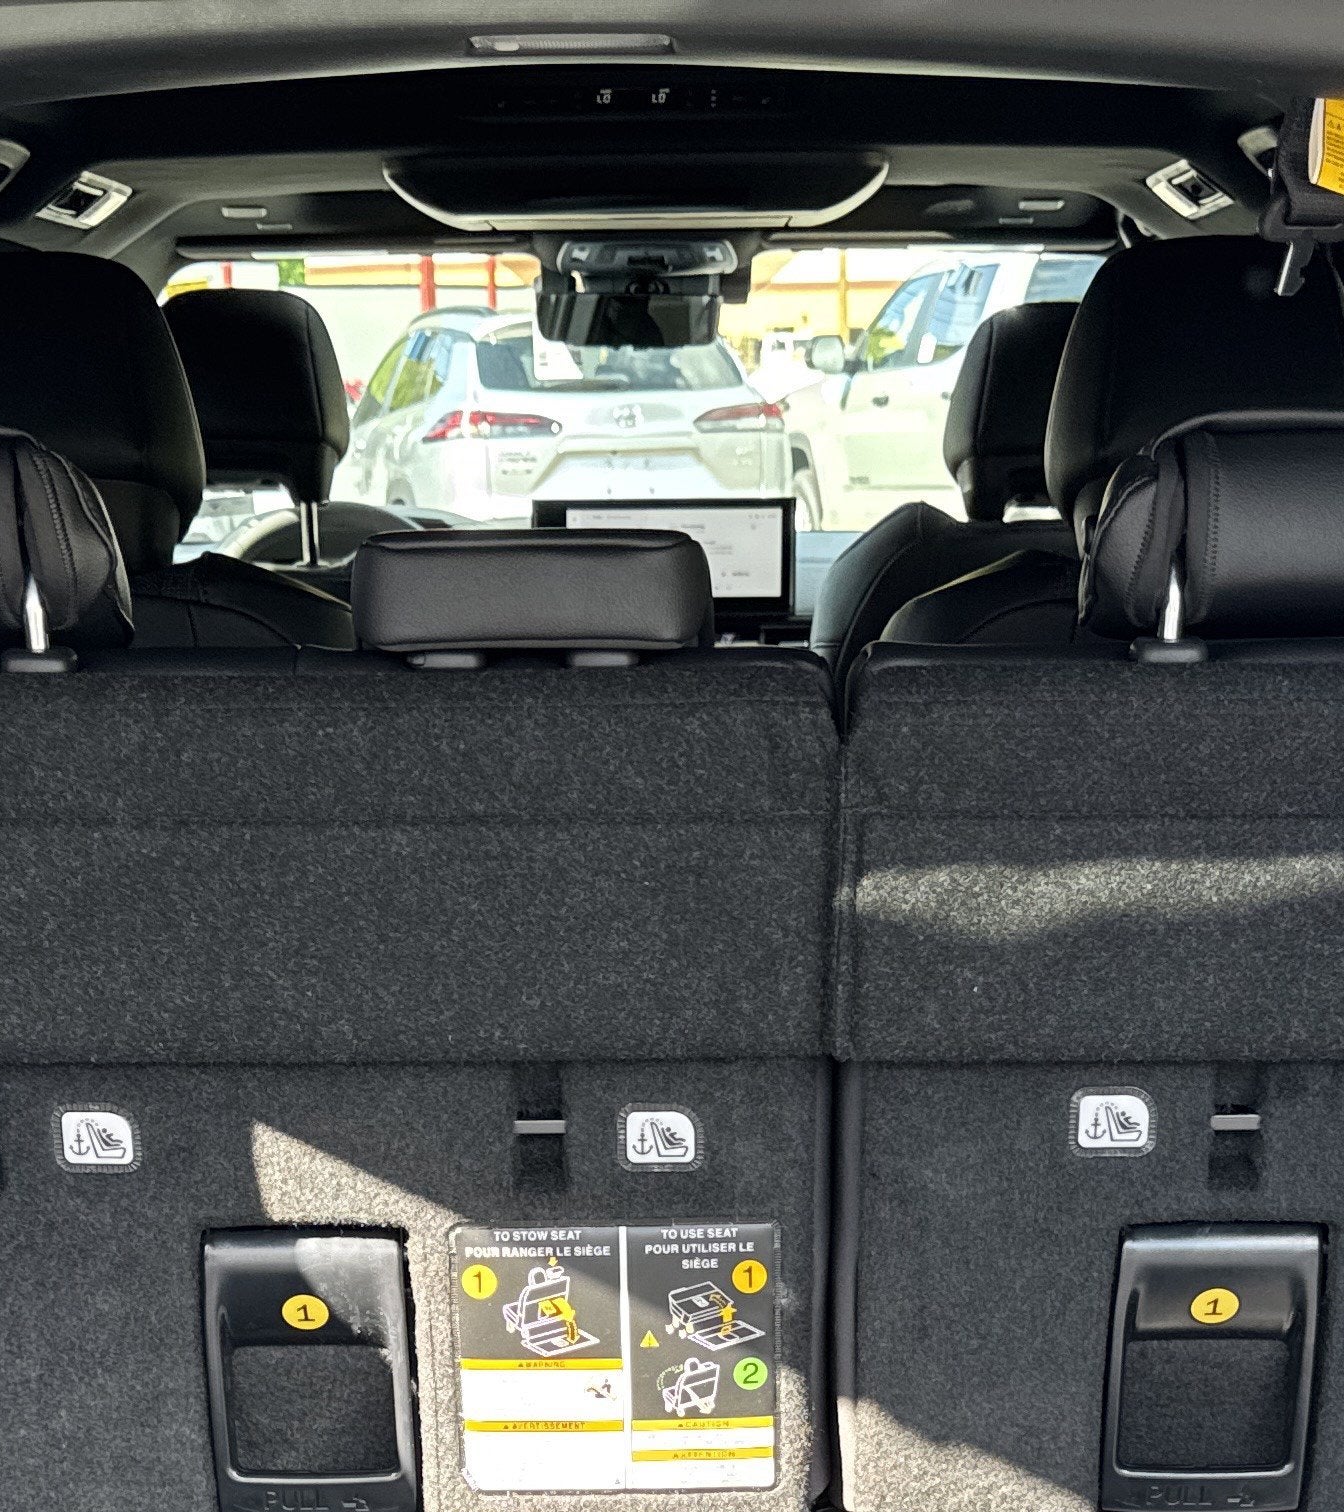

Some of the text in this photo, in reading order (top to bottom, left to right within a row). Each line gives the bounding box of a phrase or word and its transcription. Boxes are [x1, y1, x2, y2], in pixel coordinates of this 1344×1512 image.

[493, 1229, 583, 1242] TO STOW SEAT
[660, 1227, 739, 1240] TO USE SEAT
[464, 1243, 611, 1258] POUR RANGER LE SIÈGE
[644, 1241, 755, 1255] POUR UTILISER LE
[681, 1256, 719, 1270] SIÈGE
[264, 1490, 330, 1512] PULL
[1146, 1485, 1212, 1506] PULL
